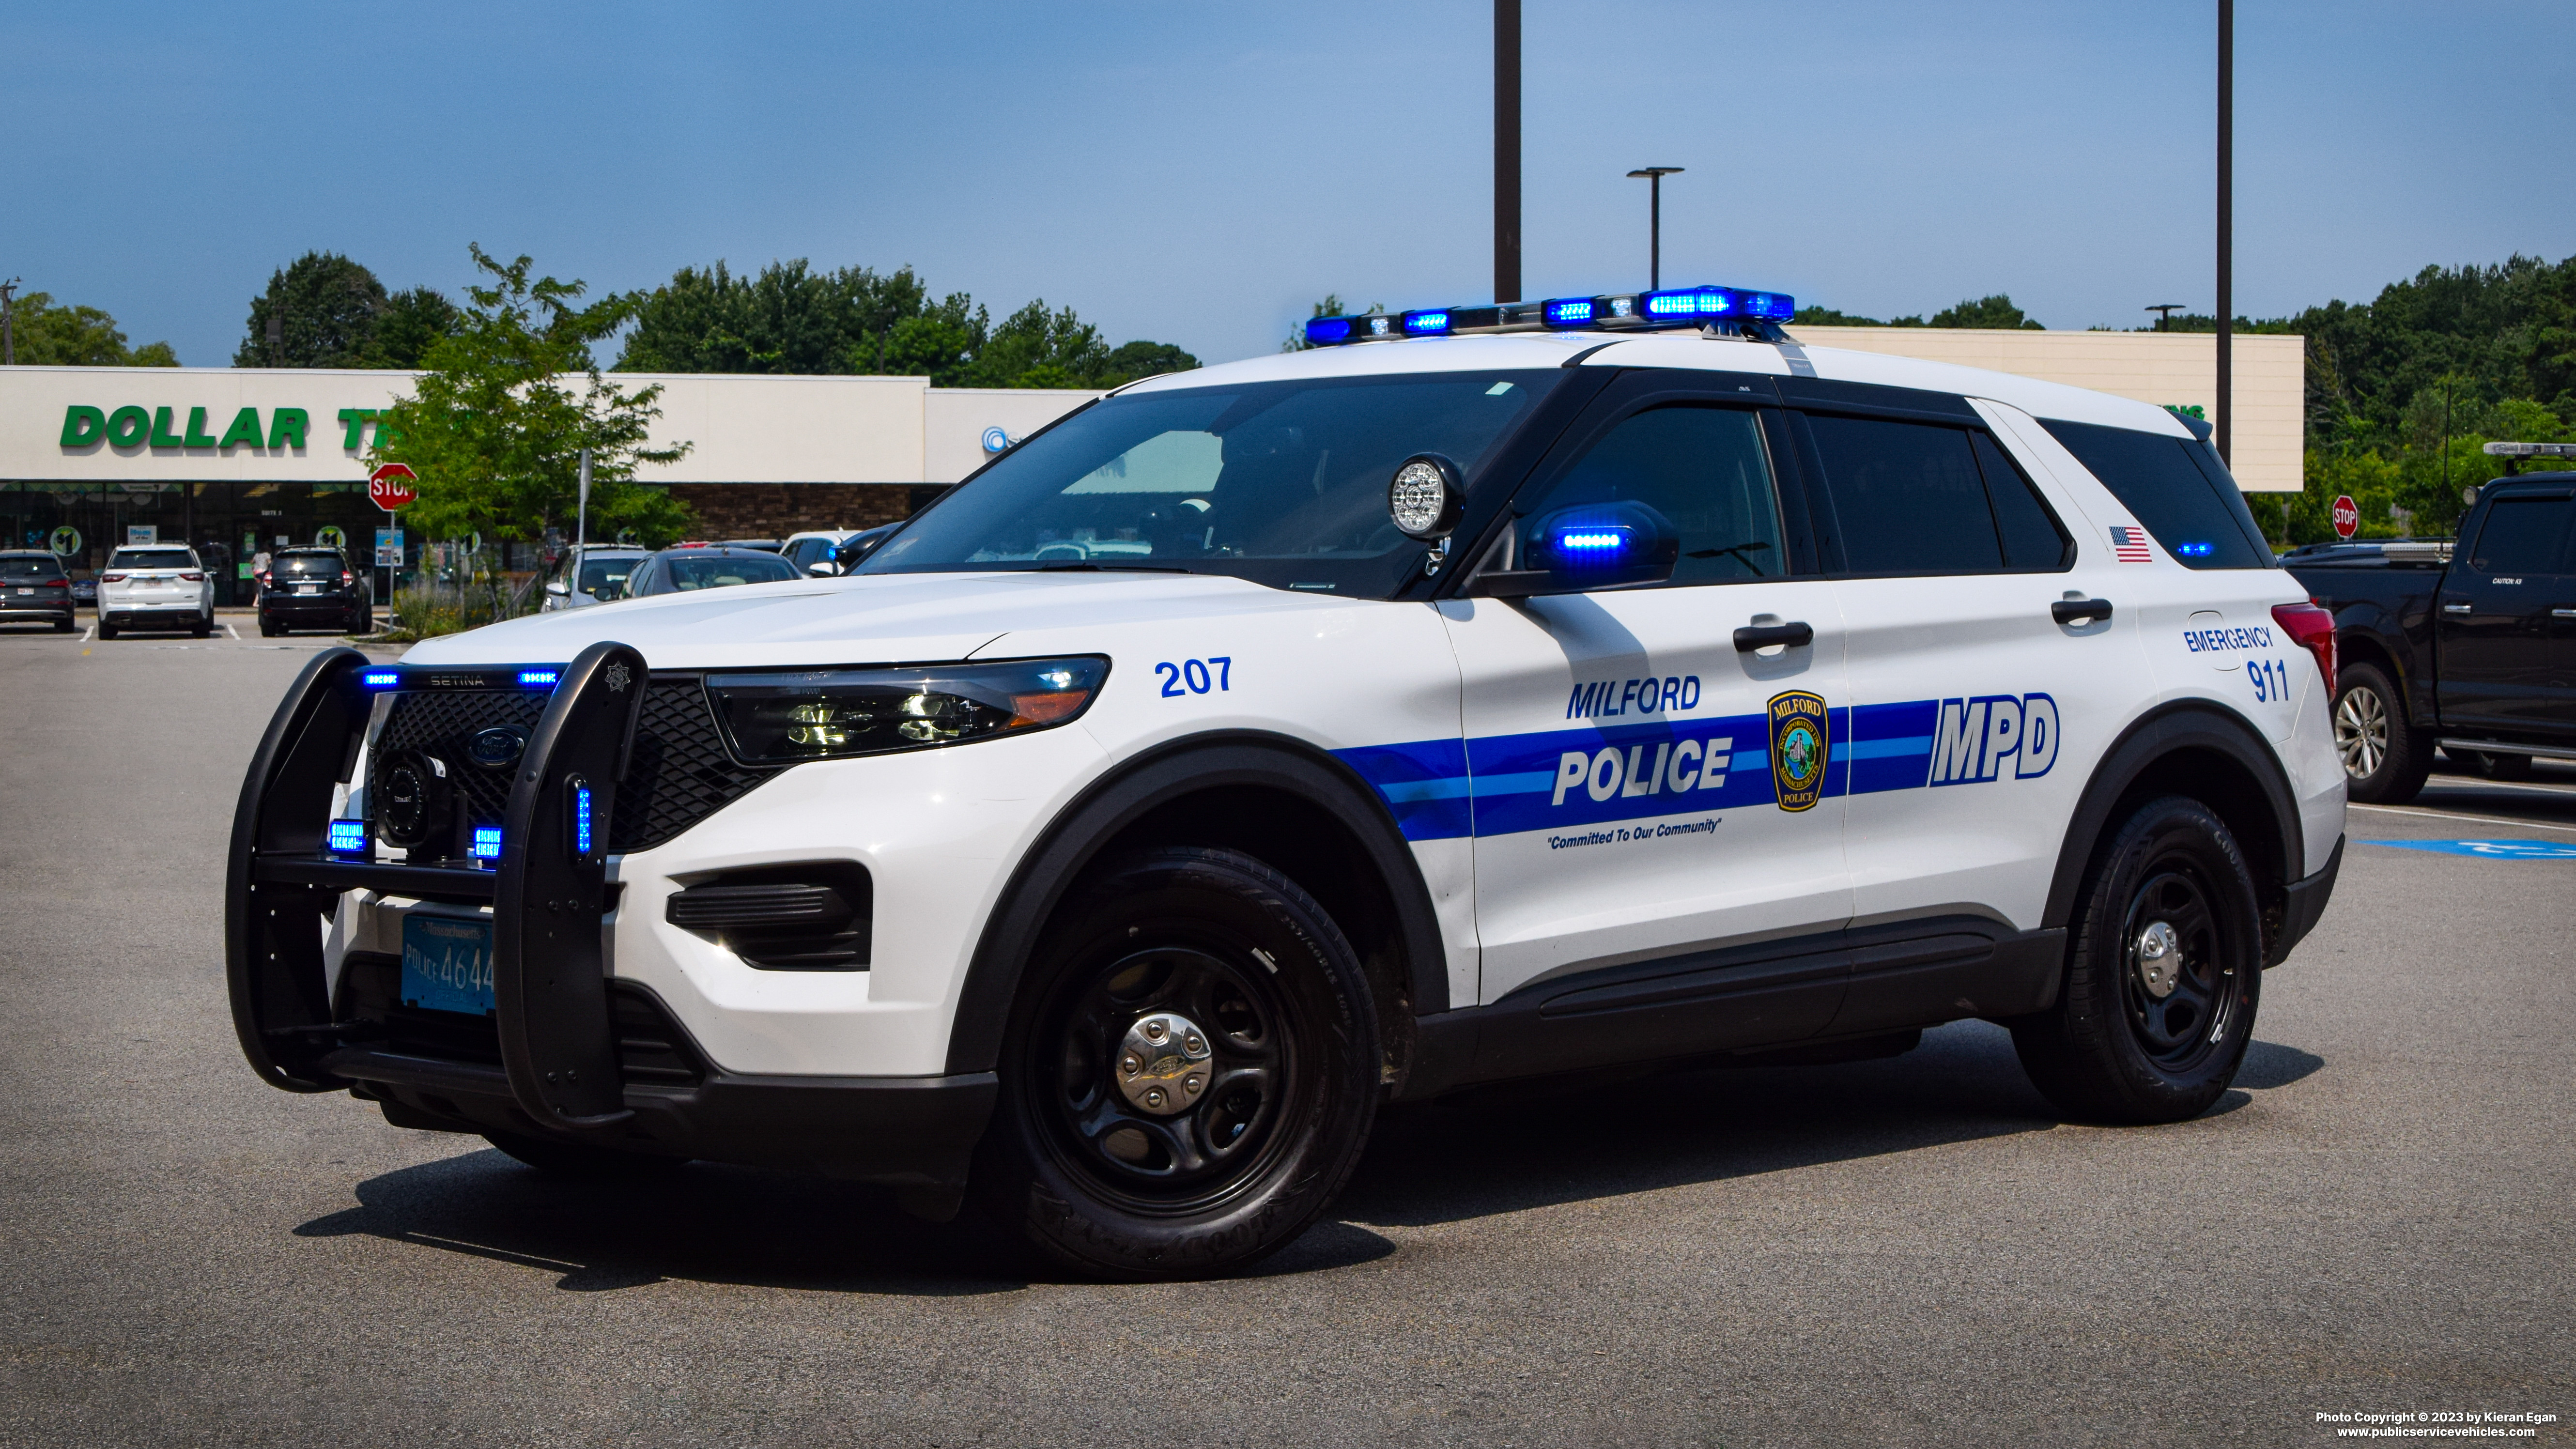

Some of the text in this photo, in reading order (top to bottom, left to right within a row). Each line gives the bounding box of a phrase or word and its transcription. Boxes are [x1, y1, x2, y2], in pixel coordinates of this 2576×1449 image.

[60, 405, 309, 448] DOLLAR
[2335, 508, 2355, 525] STOP
[2184, 627, 2273, 652] EMERGENCY
[431, 675, 484, 686] SETINA
[1155, 656, 1231, 698] 207
[2247, 659, 2288, 703] 911
[1566, 675, 1701, 719] MILFORD
[1774, 699, 1821, 720] MILFORD
[1779, 720, 1814, 750] INCORPORATED
[1929, 692, 2060, 787] MPD
[1551, 737, 1733, 806] POLICE
[1780, 765, 1819, 788] MASSACHUSETTS
[1784, 792, 1814, 804] POLICE
[1548, 817, 1722, 850] "Committed To Our Community"
[406, 943, 437, 985] POLICE
